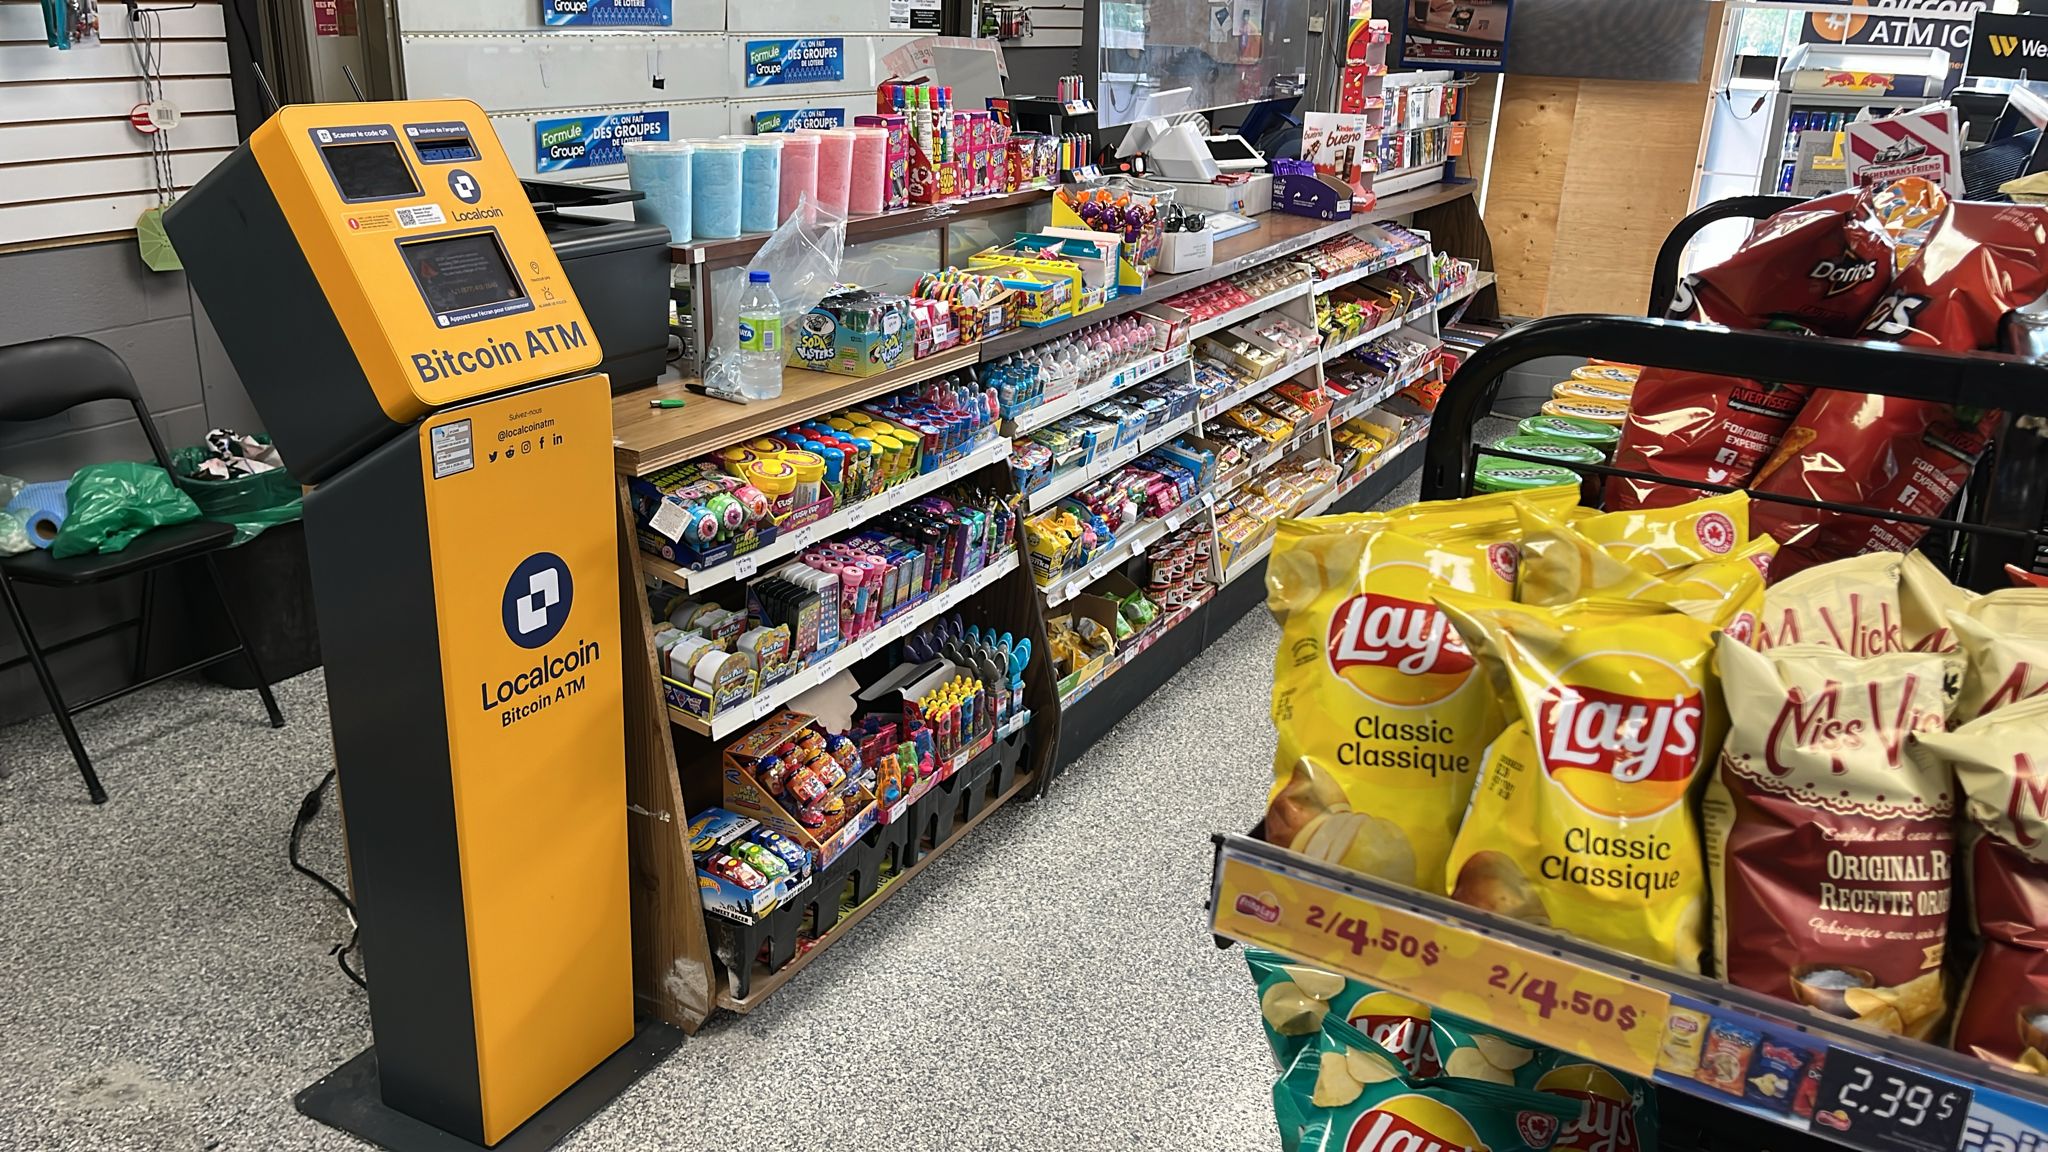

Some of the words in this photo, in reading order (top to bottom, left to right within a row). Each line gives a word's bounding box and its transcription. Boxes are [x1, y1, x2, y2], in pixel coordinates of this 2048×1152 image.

[554, 0, 587, 14] Groupe
[1868, 20, 1935, 46] ATM
[750, 46, 780, 63] Formule
[787, 49, 801, 60] DES
[803, 47, 838, 59] GROUPES
[2022, 39, 2048, 58] We
[756, 63, 781, 76] Groupe
[808, 59, 824, 67] LOTERIE
[610, 116, 620, 125] ICI,
[621, 115, 631, 123] ON
[632, 115, 644, 123] FAIT
[758, 116, 781, 133] Formule
[788, 118, 801, 129] DES
[803, 117, 838, 129] GROUPES
[332, 131, 357, 139] Scanner
[542, 125, 582, 147] Formule
[593, 127, 612, 140] DES
[614, 122, 661, 137] GROUPES
[1326, 131, 1360, 148] bueno
[612, 139, 620, 147] DE
[550, 145, 585, 160] Groupe
[1912, 163, 1941, 174] FRIEND
[452, 206, 503, 222] Localcoin
[450, 313, 471, 323] Appuyez
[802, 334, 826, 349] SODA
[412, 337, 522, 383] Bitcoin
[525, 321, 588, 359] ATM
[509, 408, 542, 421] Suivez-nous
[497, 418, 555, 442] @localcoinatm
[1723, 421, 1744, 435] FOR
[1744, 428, 1769, 441] MORE
[1912, 456, 1934, 475] FOR
[1869, 524, 1893, 542] POUR
[481, 640, 600, 711] Localcoin
[501, 692, 551, 728] Bitcoin
[554, 675, 586, 702] ATM
[1354, 716, 1454, 745] Classic
[1548, 694, 1701, 783] Lay's
[1337, 742, 1471, 778] Classique
[1565, 827, 1672, 861] Classic
[1827, 850, 1930, 882] ORIGINAL
[1930, 850, 1951, 881] R
[1540, 856, 1681, 899] Classique
[1819, 882, 1914, 917] RECETTE
[712, 906, 731, 917] SWEET
[731, 912, 749, 924] RACER
